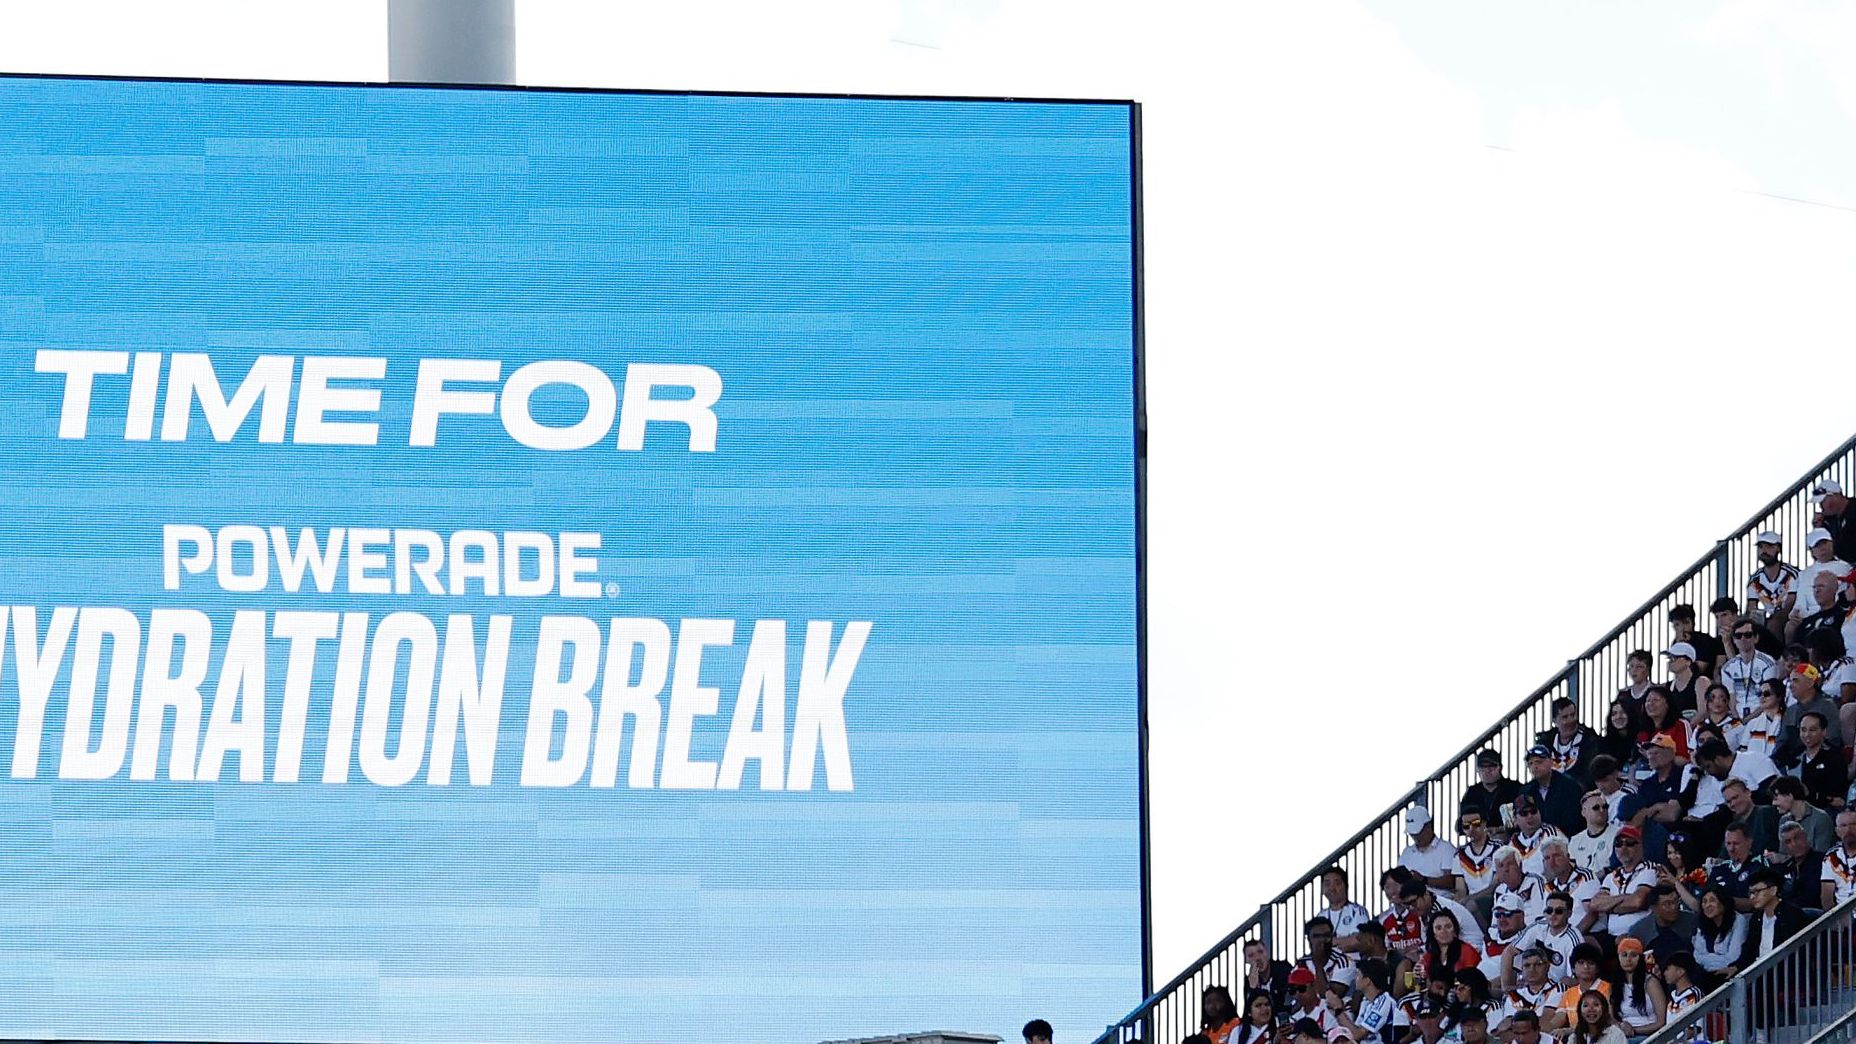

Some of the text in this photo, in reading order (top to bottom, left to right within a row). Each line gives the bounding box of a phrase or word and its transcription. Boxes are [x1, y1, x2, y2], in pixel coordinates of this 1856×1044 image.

[34, 349, 724, 453] TIME FOR
[521, 613, 874, 793] BREAK
